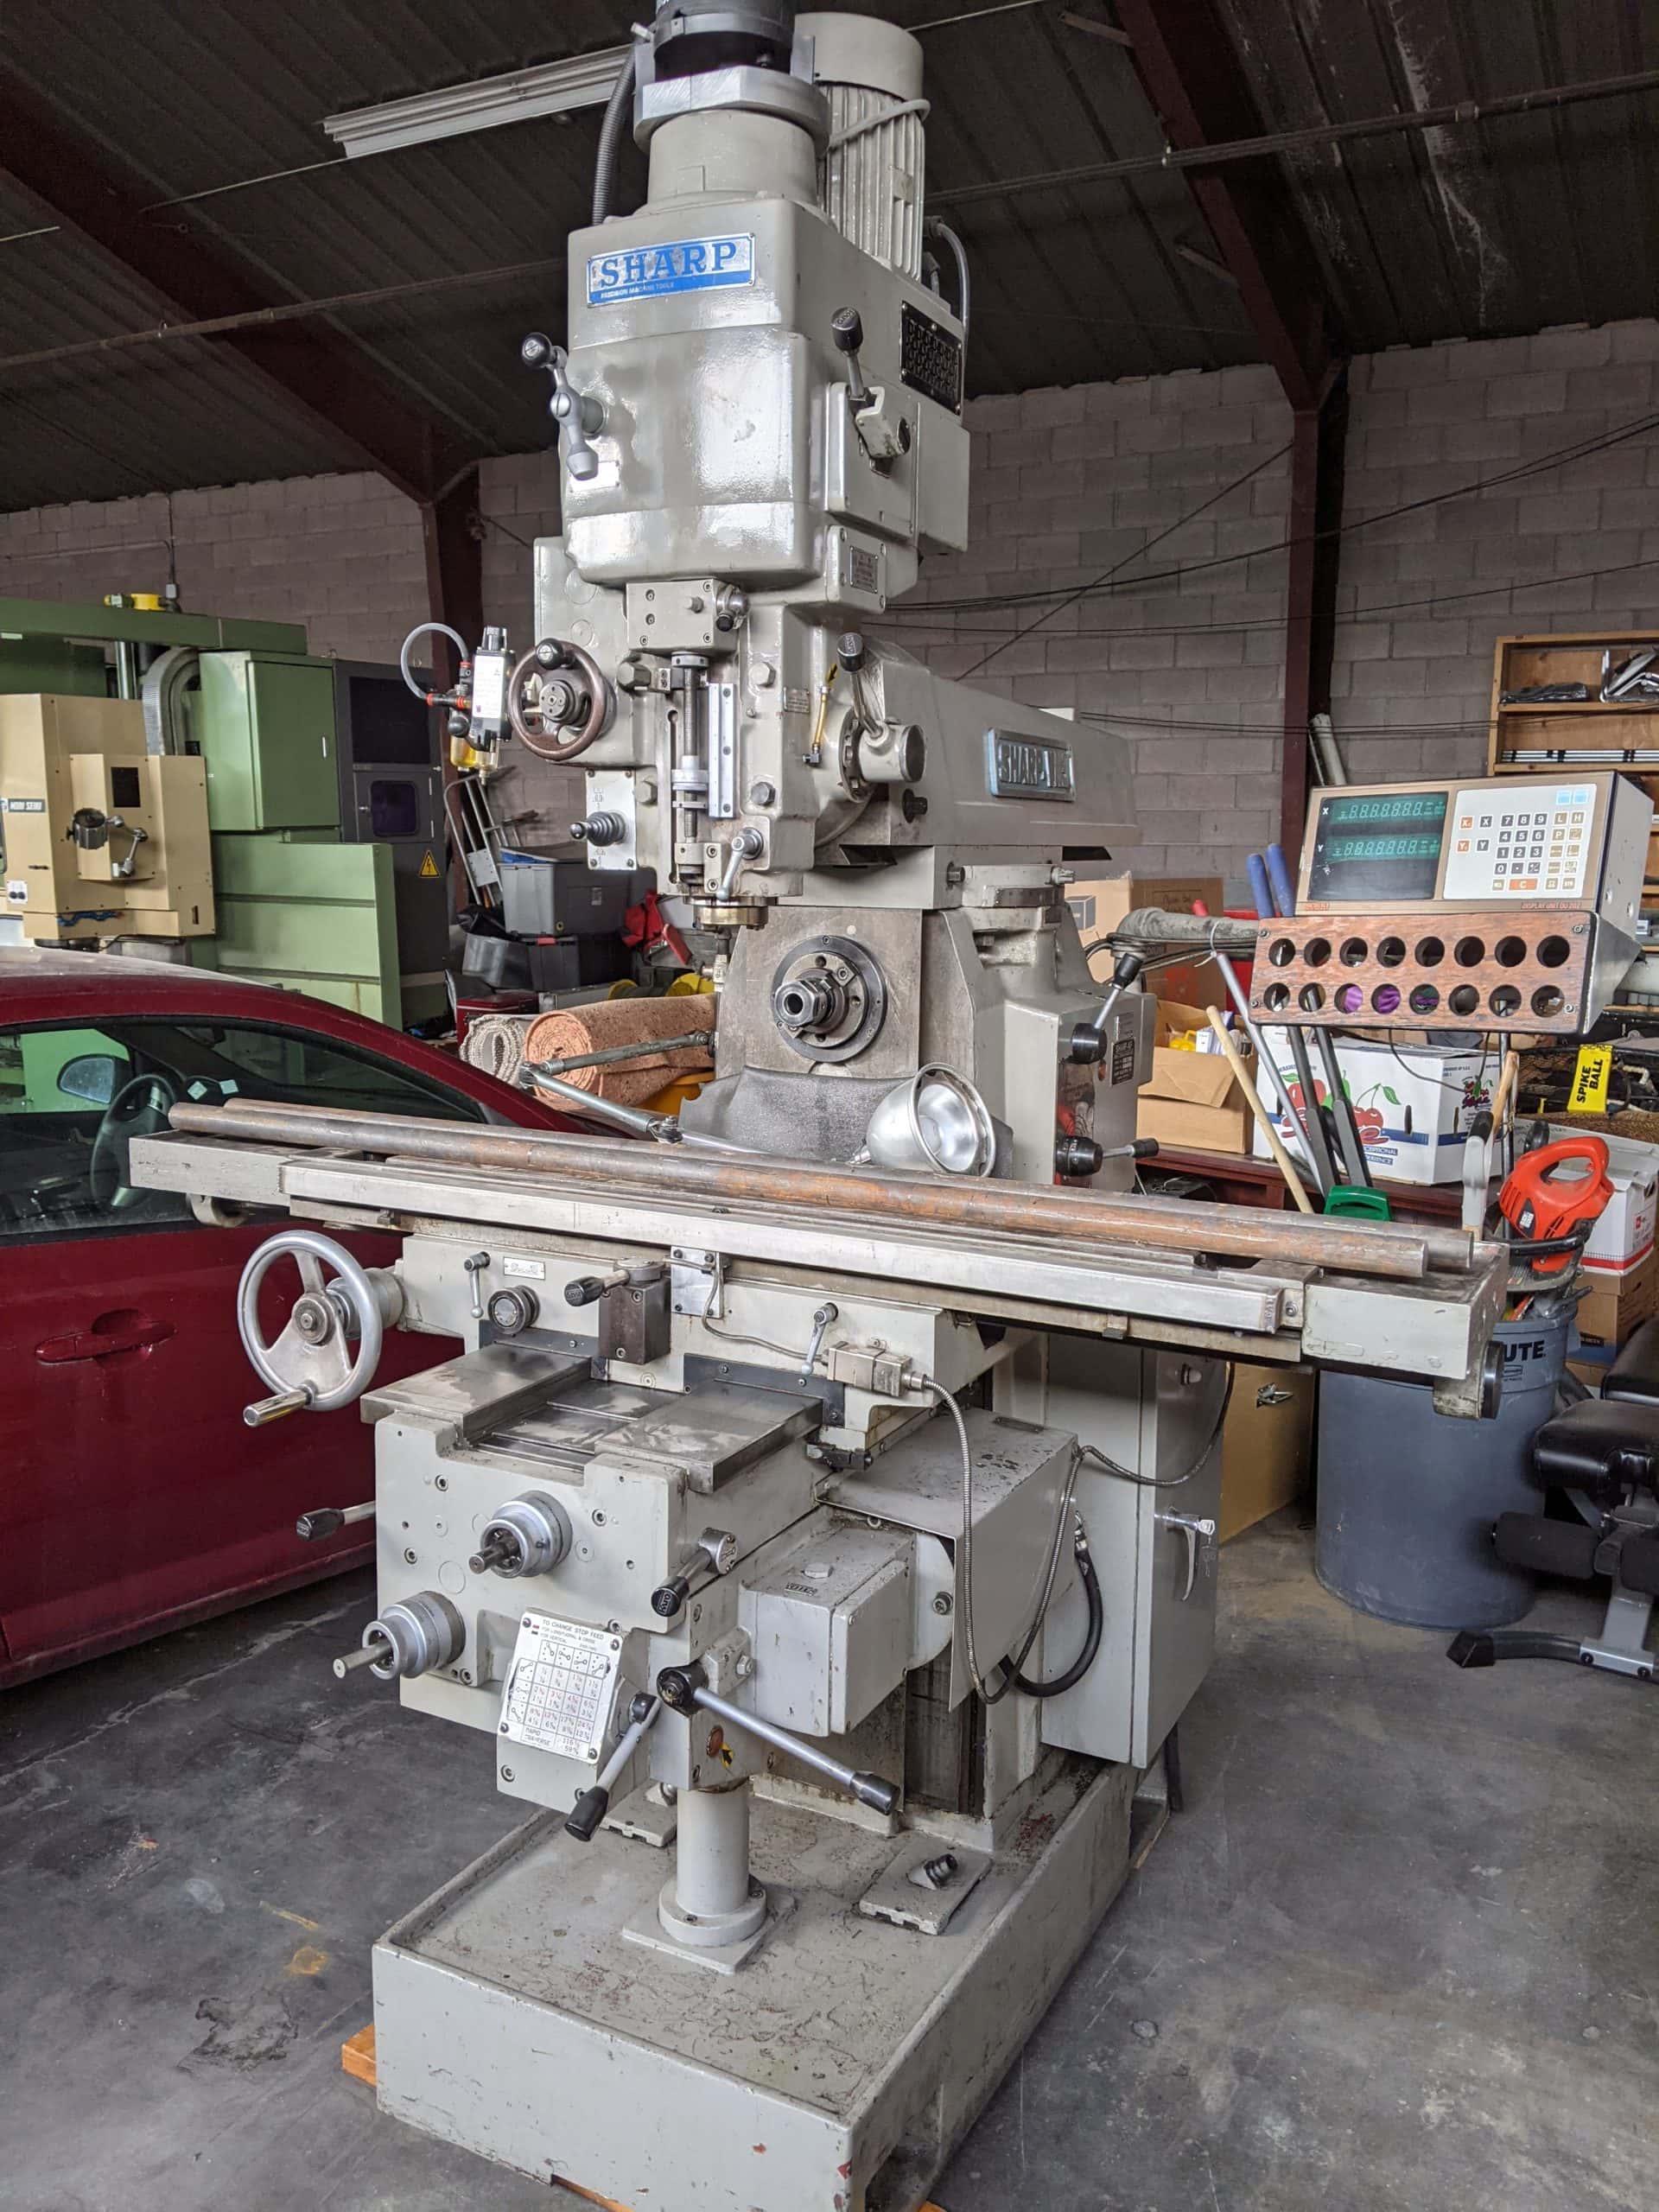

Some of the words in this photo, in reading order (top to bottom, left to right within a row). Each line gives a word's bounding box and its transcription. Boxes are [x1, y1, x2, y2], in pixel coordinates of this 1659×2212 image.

[601, 242, 737, 288] SHARP
[1483, 817, 1489, 826] X
[1504, 817, 1510, 825] 7
[1521, 816, 1527, 824] 8
[1537, 815, 1544, 823] 9
[1558, 814, 1563, 823] L
[1574, 813, 1581, 822] H
[1535, 831, 1541, 840] 6
[1556, 830, 1562, 839] P
[1318, 844, 1324, 853] Y
[1534, 848, 1540, 856] 3
[1589, 1058, 1603, 1090] BALL
[1577, 1065, 1592, 1103] SPIKE
[1504, 1340, 1545, 1362] UTE
